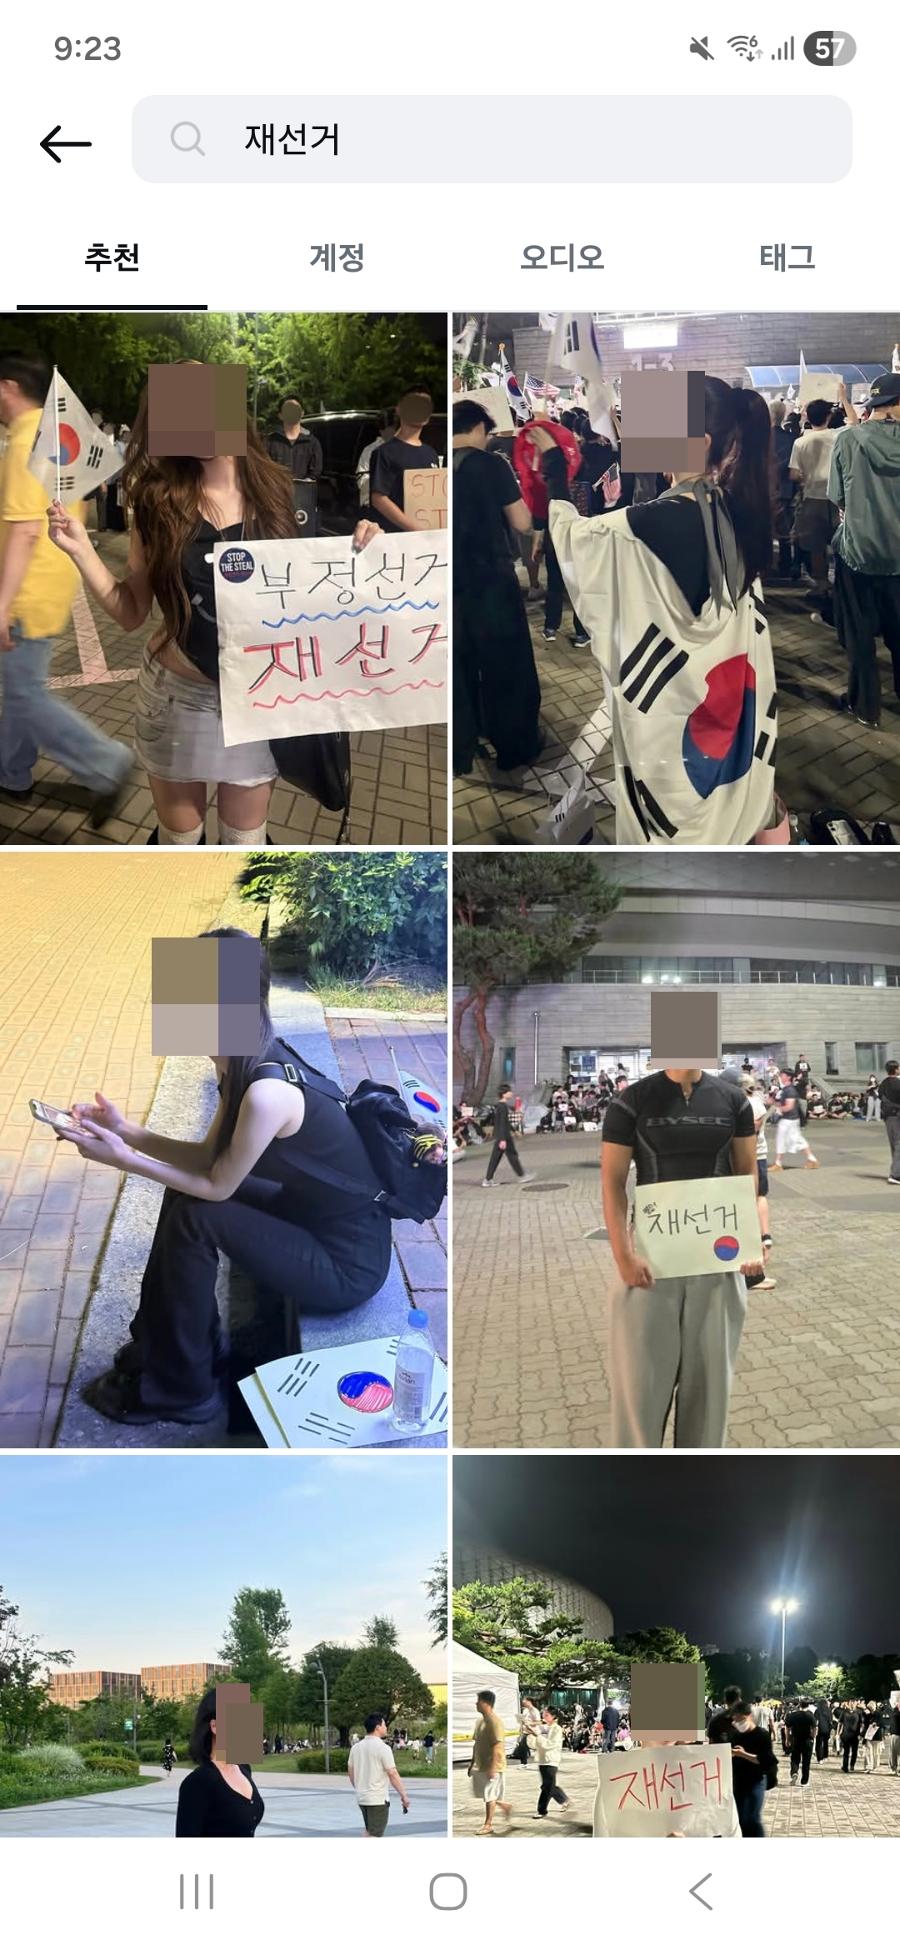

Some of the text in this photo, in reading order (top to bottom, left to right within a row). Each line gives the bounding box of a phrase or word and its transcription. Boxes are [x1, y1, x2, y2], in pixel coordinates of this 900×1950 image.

[54, 36, 122, 61] 9:23
[815, 37, 846, 60] 57
[244, 122, 339, 157] 재선거
[84, 242, 140, 273] 추천
[309, 242, 364, 273] 계정
[520, 243, 605, 273] 오디오
[760, 242, 816, 273] 태그
[221, 561, 254, 572] THE STEAL
[226, 552, 246, 562] STOP
[647, 1203, 739, 1235] 재선거
[610, 1757, 722, 1812] 재선거
